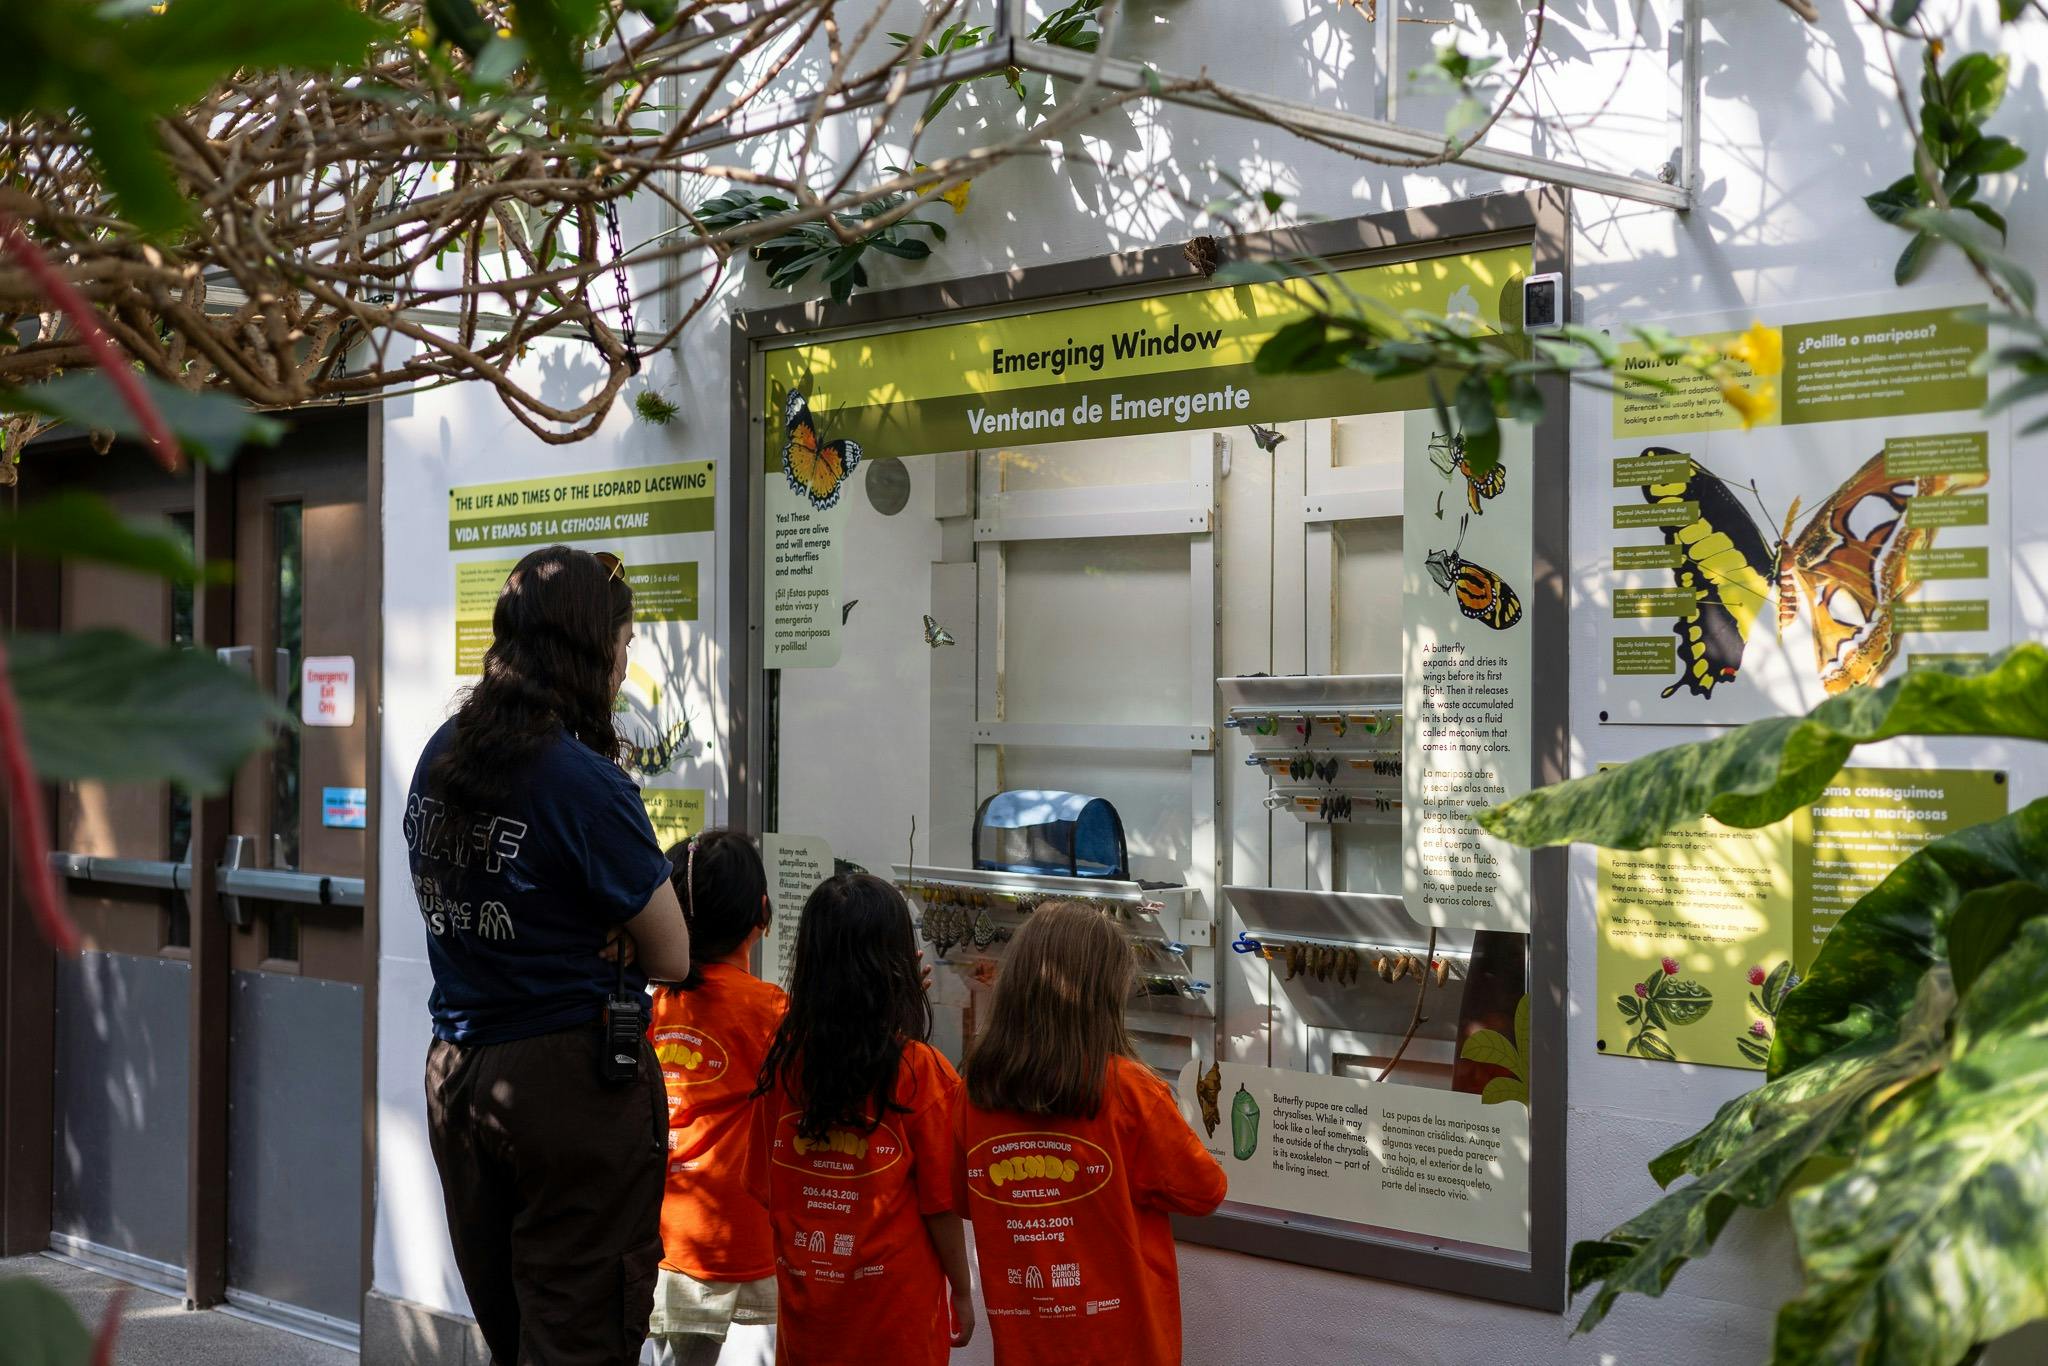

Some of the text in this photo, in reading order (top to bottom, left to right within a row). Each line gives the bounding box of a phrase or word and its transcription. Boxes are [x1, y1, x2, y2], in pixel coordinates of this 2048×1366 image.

[1798, 324, 1937, 355] ¿Polilla o mariposa?
[993, 324, 1222, 375] Emerging Window
[967, 384, 1250, 434] Ventana de Emergente
[1624, 416, 1647, 425] looking
[1663, 413, 1680, 421] moth
[456, 473, 706, 511] THE LIFE AND TIMES OF THE LEOPARD LACEWING
[776, 512, 810, 523] Yes! These
[455, 512, 650, 543] VIDA Y ETAPAS DE LA CETHOSIA CYANE
[776, 524, 829, 539] pupae are alive
[776, 539, 831, 550] and will emerge
[776, 552, 819, 563] as butterflies
[776, 566, 813, 577] and moths!
[807, 589, 829, 598] pupas
[775, 601, 819, 613] están vivas y
[775, 615, 813, 627] emergerán
[775, 628, 831, 640] como mariposas
[775, 641, 807, 653] y polillas!
[1423, 642, 1465, 655] A butterfly
[1423, 657, 1508, 669] expands and dries its
[307, 670, 349, 684] Emergency
[1423, 670, 1502, 683] wings before its first
[320, 685, 335, 698] Exit
[1423, 685, 1509, 697] flight. Then it releases
[319, 702, 336, 716] Only
[1422, 699, 1514, 709] the waste accumulated
[1422, 712, 1503, 725] in its body as a fluid
[1855, 785, 1944, 801] conseguimos
[1812, 806, 1947, 823] nuestras mariposas
[1423, 881, 1496, 893] nio, que puede ser
[1423, 894, 1493, 907] de varios colores.
[1612, 916, 1622, 924] We
[1623, 917, 1640, 926] bring
[1641, 918, 1652, 926] out
[1668, 919, 1700, 928] butterflies
[1273, 1093, 1368, 1115] Butterfly pupae are called
[1273, 1107, 1363, 1130] chrysalises. While it may
[1382, 1108, 1500, 1134] Las pupas de las mariposas se
[1273, 1120, 1288, 1131] look
[1290, 1122, 1303, 1133] like
[1311, 1125, 1326, 1136] leaf
[1327, 1130, 1368, 1144] sometimes,
[1382, 1123, 1500, 1149] denominan crisálidas. Aunque
[876, 1146, 896, 1154] 1977
[992, 1140, 1072, 1154] CAMPS FOR CURIOUS
[1273, 1133, 1369, 1157] the outside of the chrysalis
[968, 1154, 1105, 1187] EST. MINDS 1977
[1272, 1159, 1330, 1178] the living insect.
[802, 1186, 859, 1201] 206.443.2001
[807, 1200, 851, 1214] pacsci.org
[1006, 1217, 1074, 1230] 206.443.2001
[1013, 1231, 1065, 1243] pacsci.org
[1008, 1264, 1076, 1277] PAC CAMPS
[1008, 1270, 1080, 1285] SCI CURIOUS
[1052, 1277, 1081, 1288] MINDS
[1098, 1298, 1121, 1307] PEMCO
